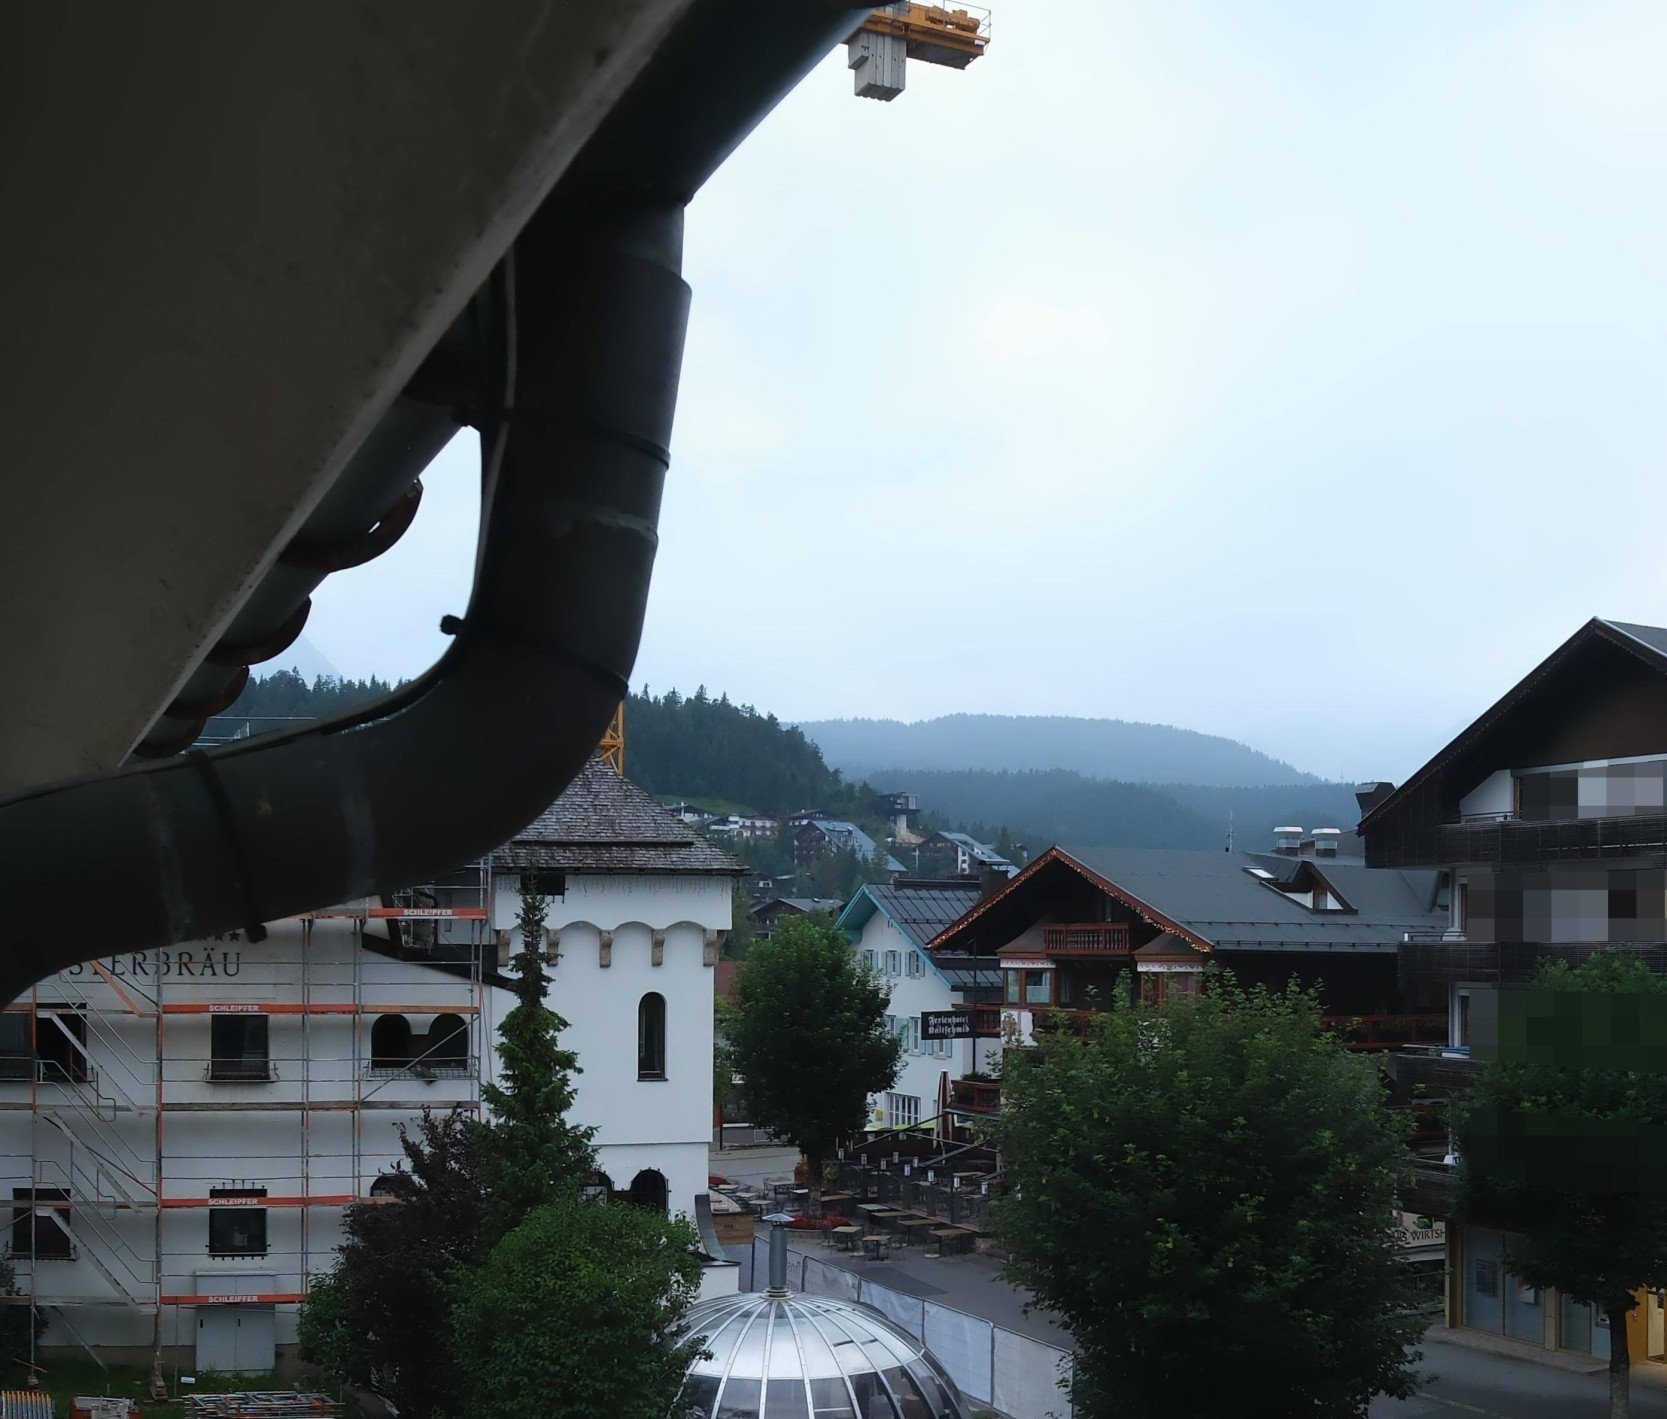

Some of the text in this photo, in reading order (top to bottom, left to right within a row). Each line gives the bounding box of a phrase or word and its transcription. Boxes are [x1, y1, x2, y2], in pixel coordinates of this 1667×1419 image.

[208, 1003, 259, 1013] SCHLEIPFER
[208, 1197, 258, 1207] SCHLEIPFER
[208, 1295, 258, 1303] SCHLEIPFER
